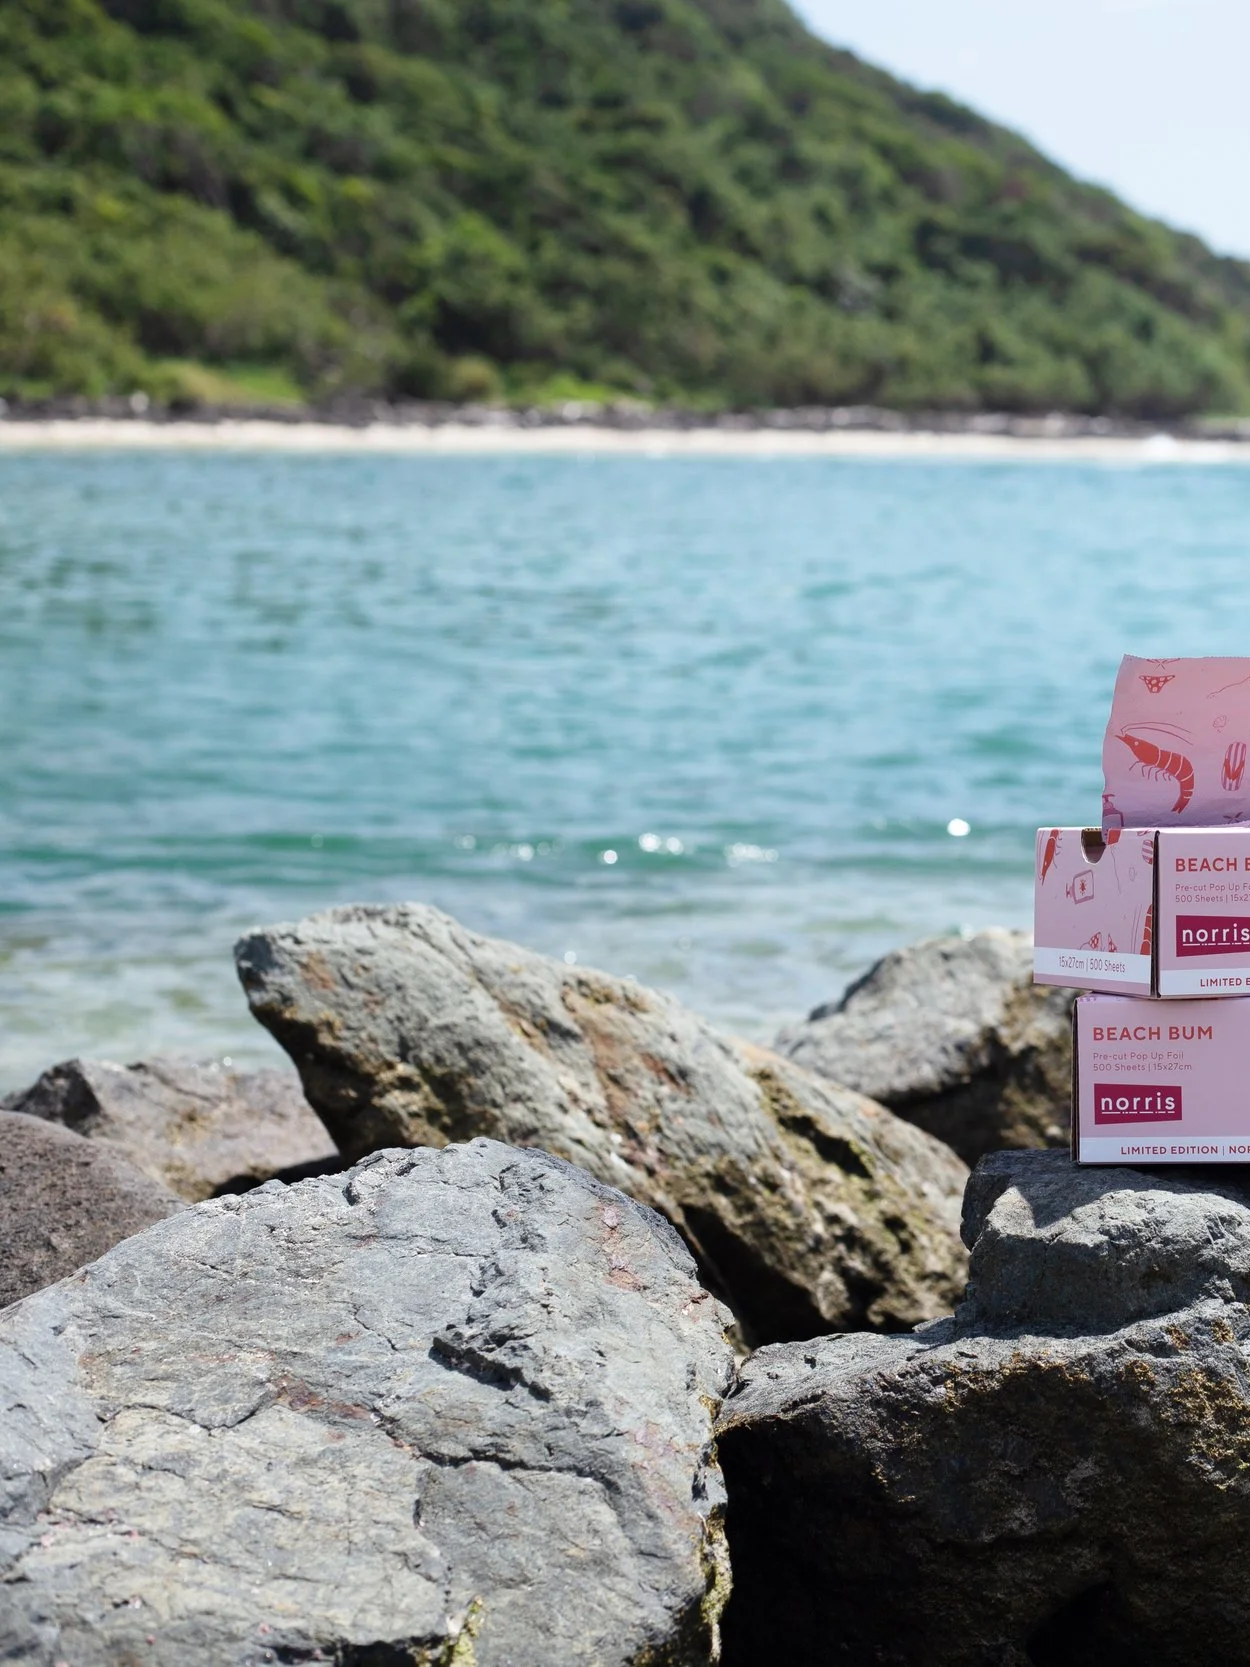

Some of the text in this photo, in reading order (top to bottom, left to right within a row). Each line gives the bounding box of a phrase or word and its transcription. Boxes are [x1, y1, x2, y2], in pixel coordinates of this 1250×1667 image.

[1175, 857, 1238, 873] BEACH
[1175, 883, 1207, 893] Pre-cut
[1209, 883, 1226, 893] Pop
[1228, 883, 1241, 893] Up
[1175, 894, 1193, 903] 500
[1194, 894, 1224, 903] Sheets
[1182, 922, 1250, 943] norris
[1058, 956, 1085, 970] 15x27cm
[1089, 958, 1103, 971] 500
[1103, 960, 1126, 974] Sheets
[1199, 977, 1243, 988] LIMITED
[1092, 1025, 1214, 1041] BEACH BUM
[1092, 1051, 1185, 1062] Pre-cut Pop Up Foil
[1092, 1063, 1113, 1072] 500
[1114, 1063, 1146, 1072] Sheets
[1153, 1062, 1193, 1071] 15x27cm
[1100, 1091, 1176, 1111] norris
[1120, 1146, 1168, 1155] LIMITED
[1170, 1145, 1219, 1155] EDITION
